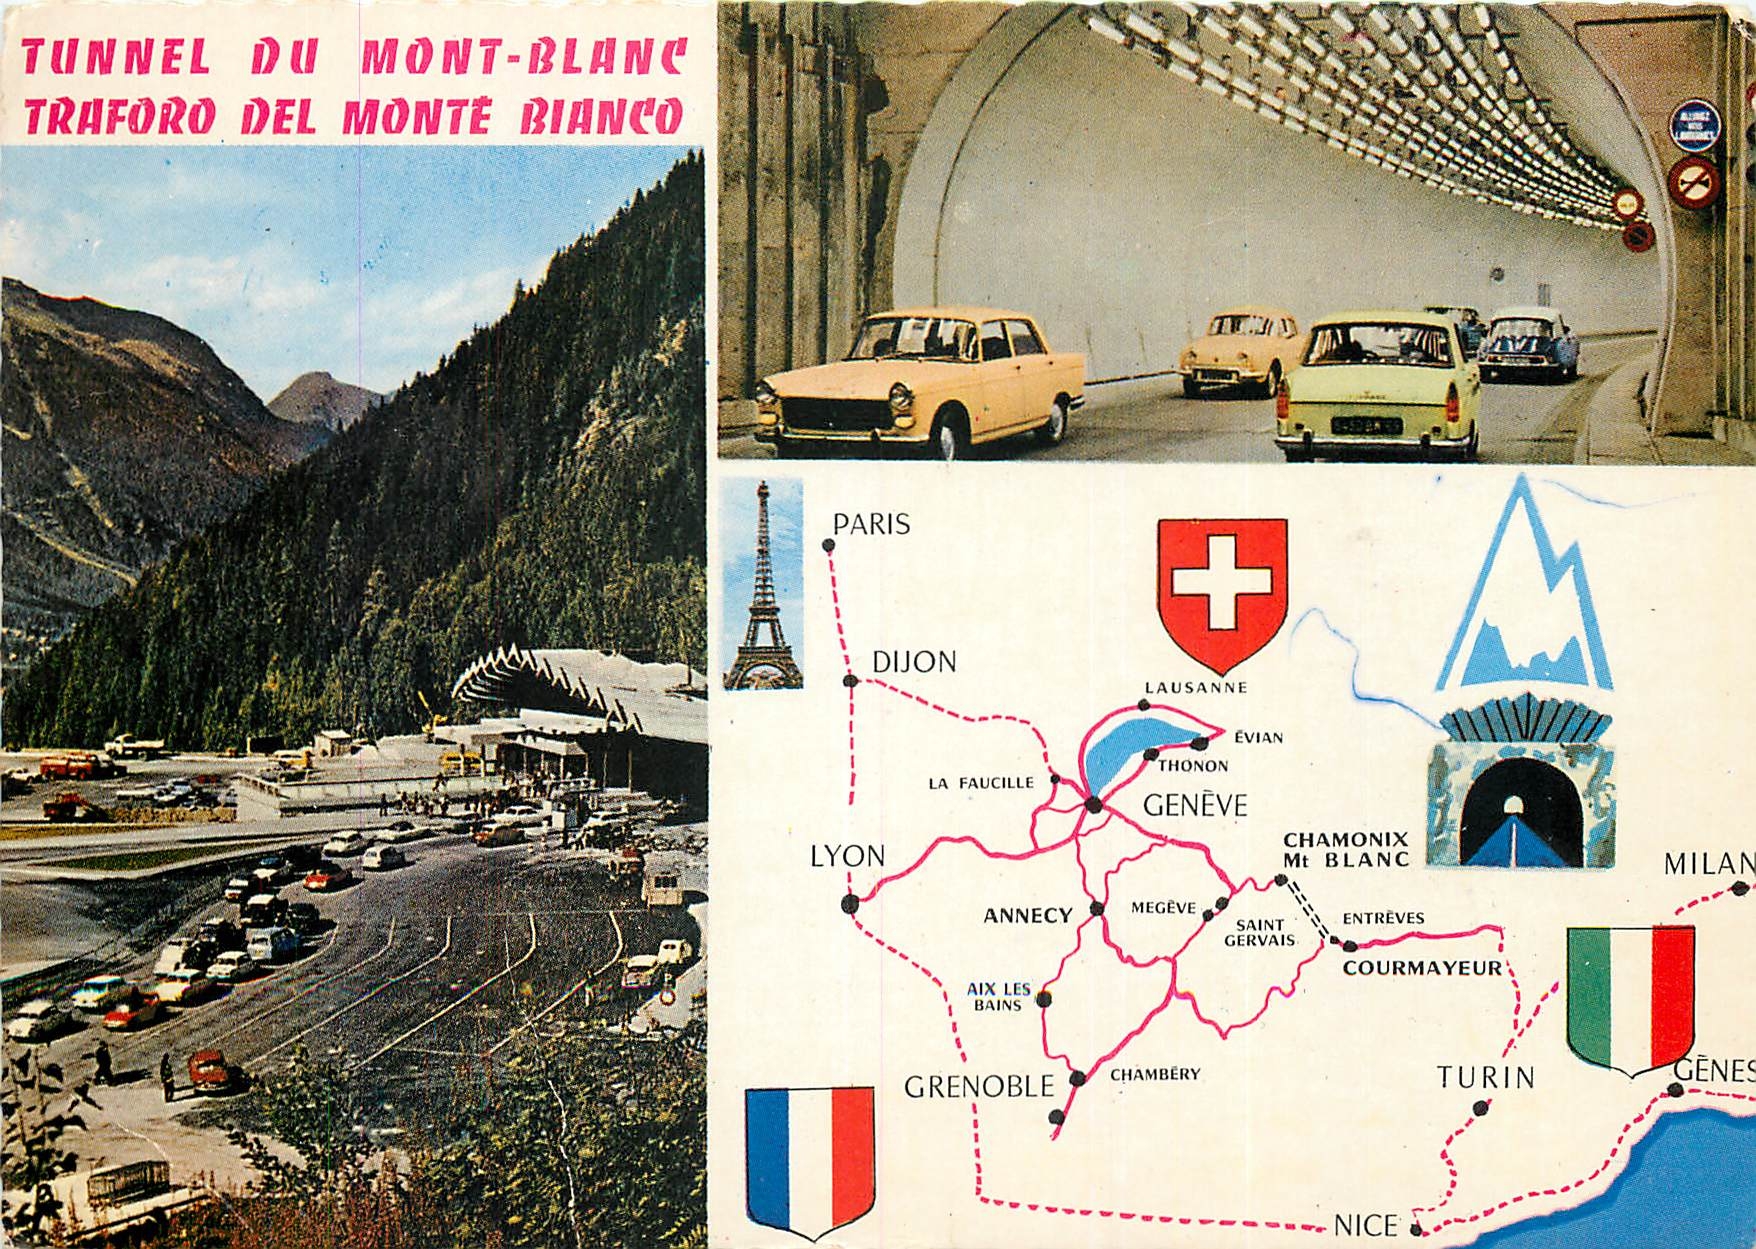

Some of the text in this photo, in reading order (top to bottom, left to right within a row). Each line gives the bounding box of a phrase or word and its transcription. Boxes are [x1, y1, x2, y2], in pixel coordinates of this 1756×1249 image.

[21, 36, 689, 76] TUNNEL DU MONT-BLANC
[24, 96, 217, 135] TRAFORO
[240, 96, 316, 135] DEL
[520, 96, 683, 136] BIANCO
[834, 512, 911, 536] PARIS
[873, 650, 957, 673] DIJON
[1145, 681, 1247, 694] LAUSANNE
[1158, 759, 1229, 773] THONON
[929, 776, 1034, 790] LA FAUCILLE
[1283, 831, 1409, 848] CHAMONIX
[811, 844, 886, 868] LYON
[1284, 851, 1409, 868] Mt BLANC
[1665, 851, 1756, 875] MILAN
[983, 907, 1074, 924] ANNECY
[1236, 919, 1285, 932] SAINT
[1224, 934, 1295, 947] GERVAIS
[1343, 960, 1503, 976] COURMAYEUR
[967, 982, 1031, 997] AIX LES
[974, 999, 1022, 1012] BAINS
[1437, 1065, 1535, 1089] TURIN
[904, 1074, 1055, 1099] GRENOBLE
[1335, 1213, 1398, 1237] NICE
